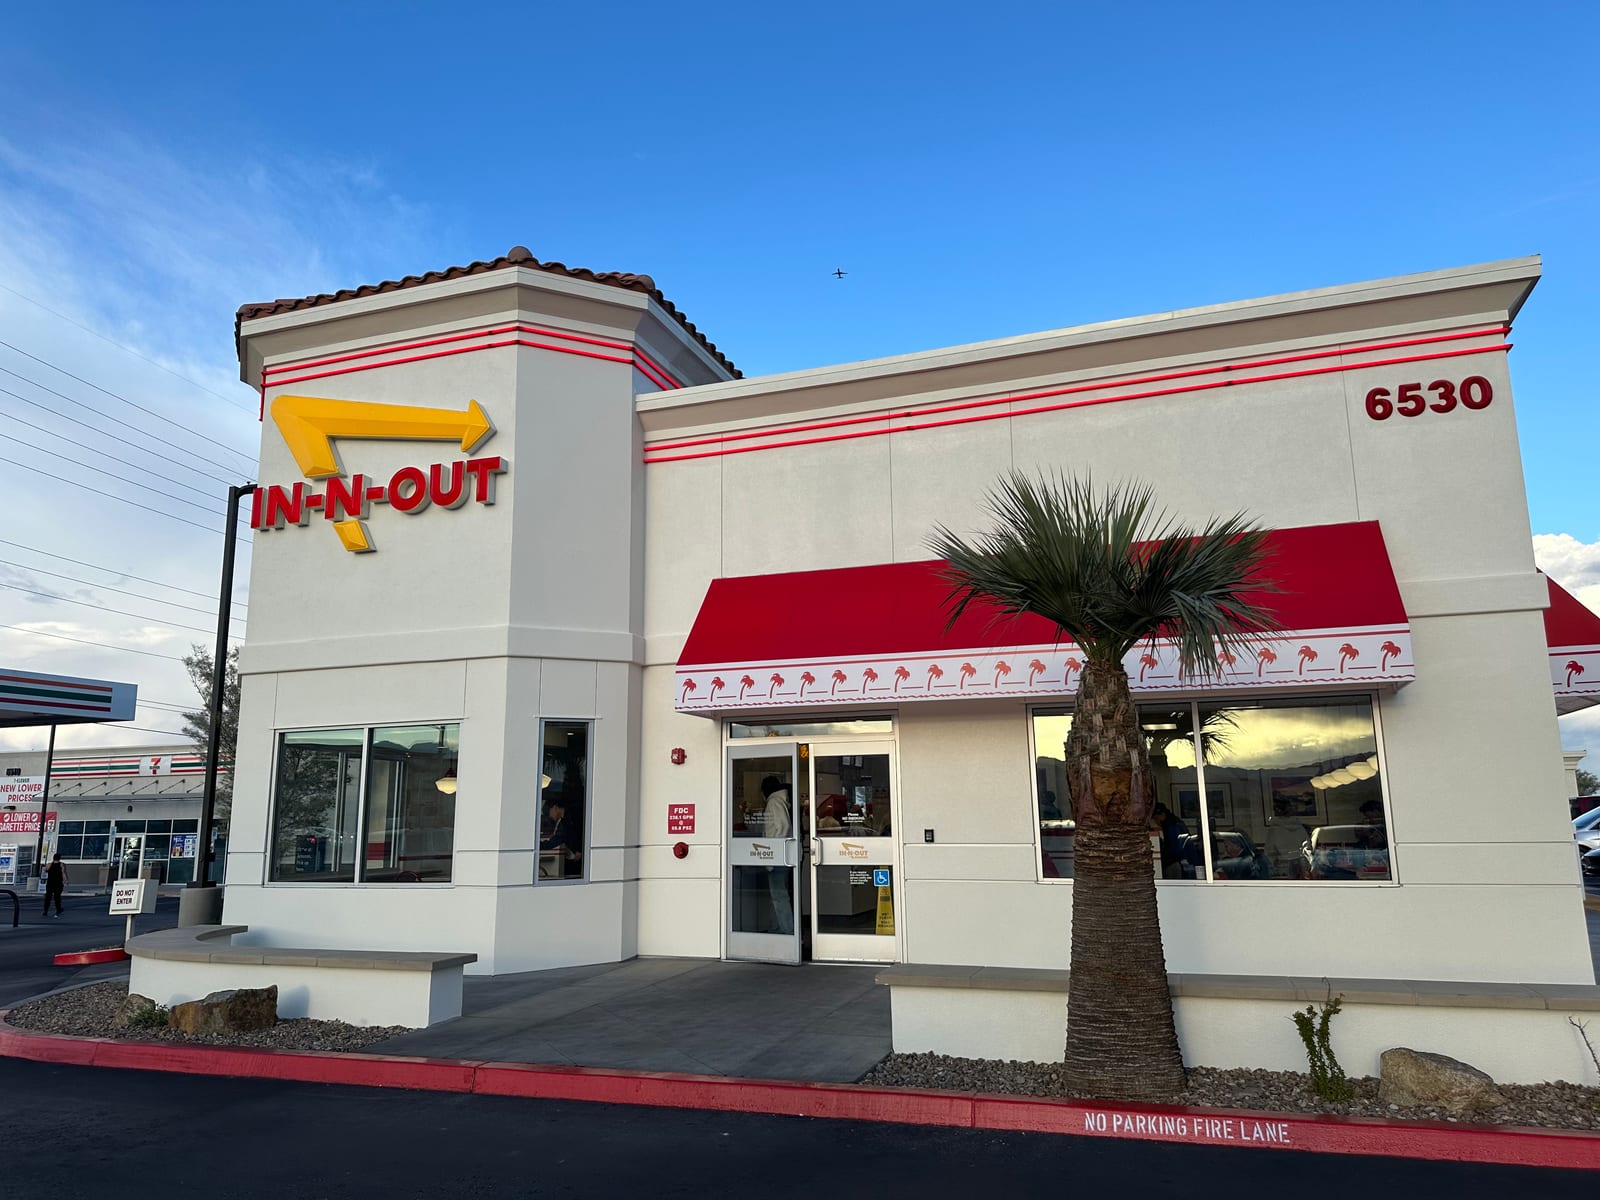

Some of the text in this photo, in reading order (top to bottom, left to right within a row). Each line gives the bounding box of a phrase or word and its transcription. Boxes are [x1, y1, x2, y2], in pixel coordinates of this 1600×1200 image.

[1365, 375, 1493, 421] 6530
[250, 456, 506, 530] IN-N-OUT
[18, 784, 42, 792] LOWER
[8, 794, 33, 802] PRICES
[11, 813, 31, 822] LOWER
[25, 822, 47, 832] PRICE
[124, 889, 135, 897] NOT
[116, 897, 132, 905] ENTER
[1085, 1112, 1290, 1143] NO PARKING FIRE LANE
